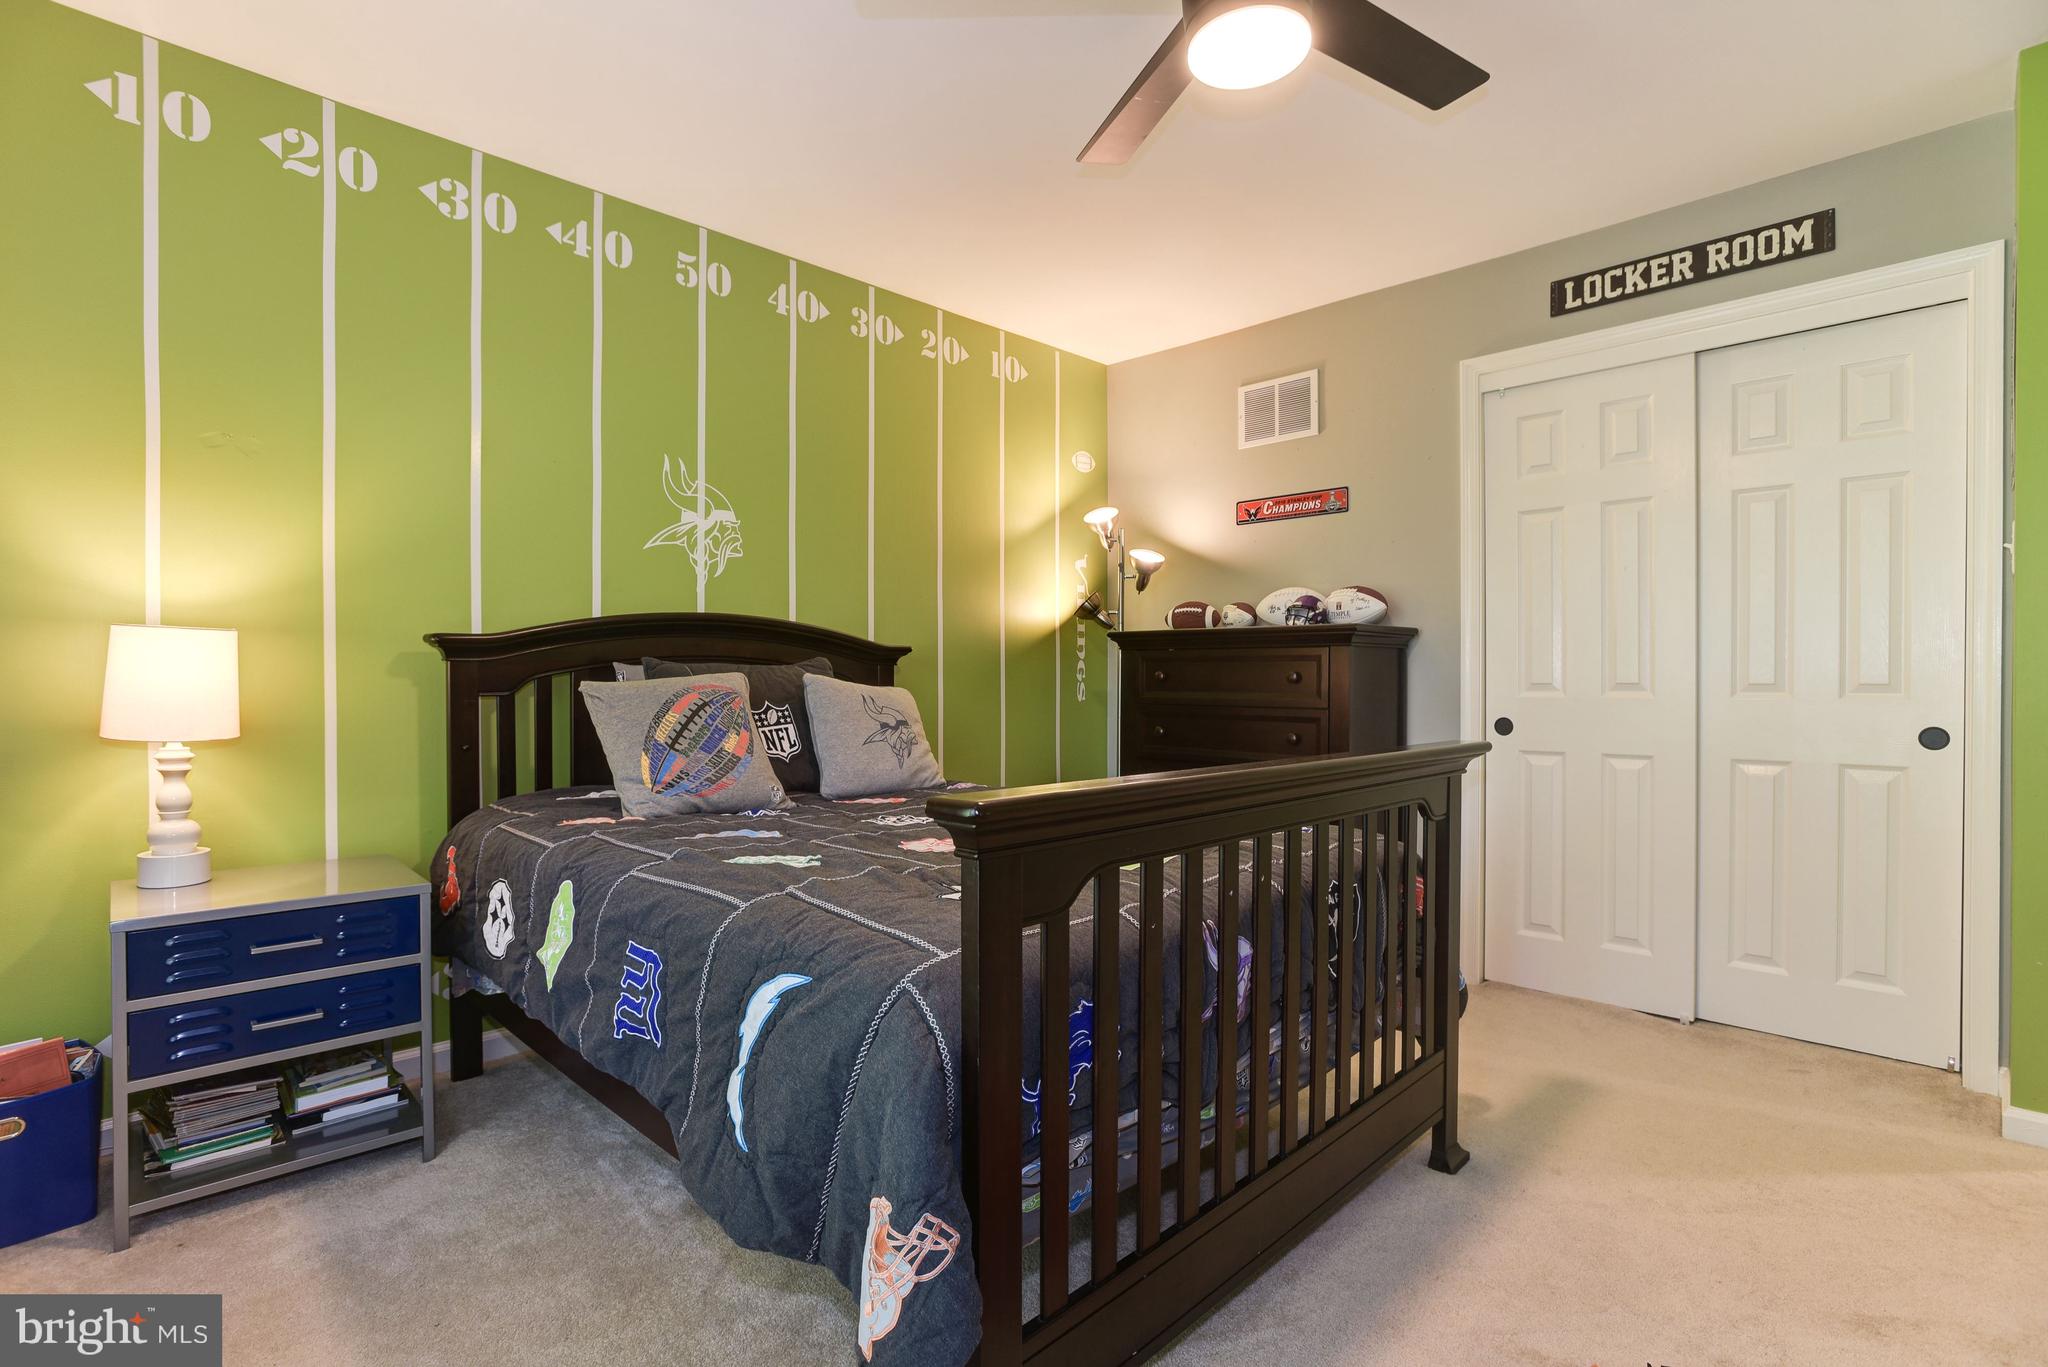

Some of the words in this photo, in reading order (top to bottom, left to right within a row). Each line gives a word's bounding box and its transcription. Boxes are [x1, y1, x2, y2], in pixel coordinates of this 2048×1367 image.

[113, 71, 211, 142] 10
[282, 127, 378, 192] 20
[438, 178, 517, 234] 30
[562, 220, 633, 269] 40
[1564, 250, 1694, 310] LOCKER
[1706, 218, 1815, 275] ROOM
[676, 251, 731, 297] 50
[768, 283, 819, 323] 40
[851, 307, 896, 345] 30
[921, 329, 962, 365] 20
[991, 351, 1020, 383] 10
[1263, 500, 1321, 515] CHAMPIONS
[761, 726, 798, 753] NFL
